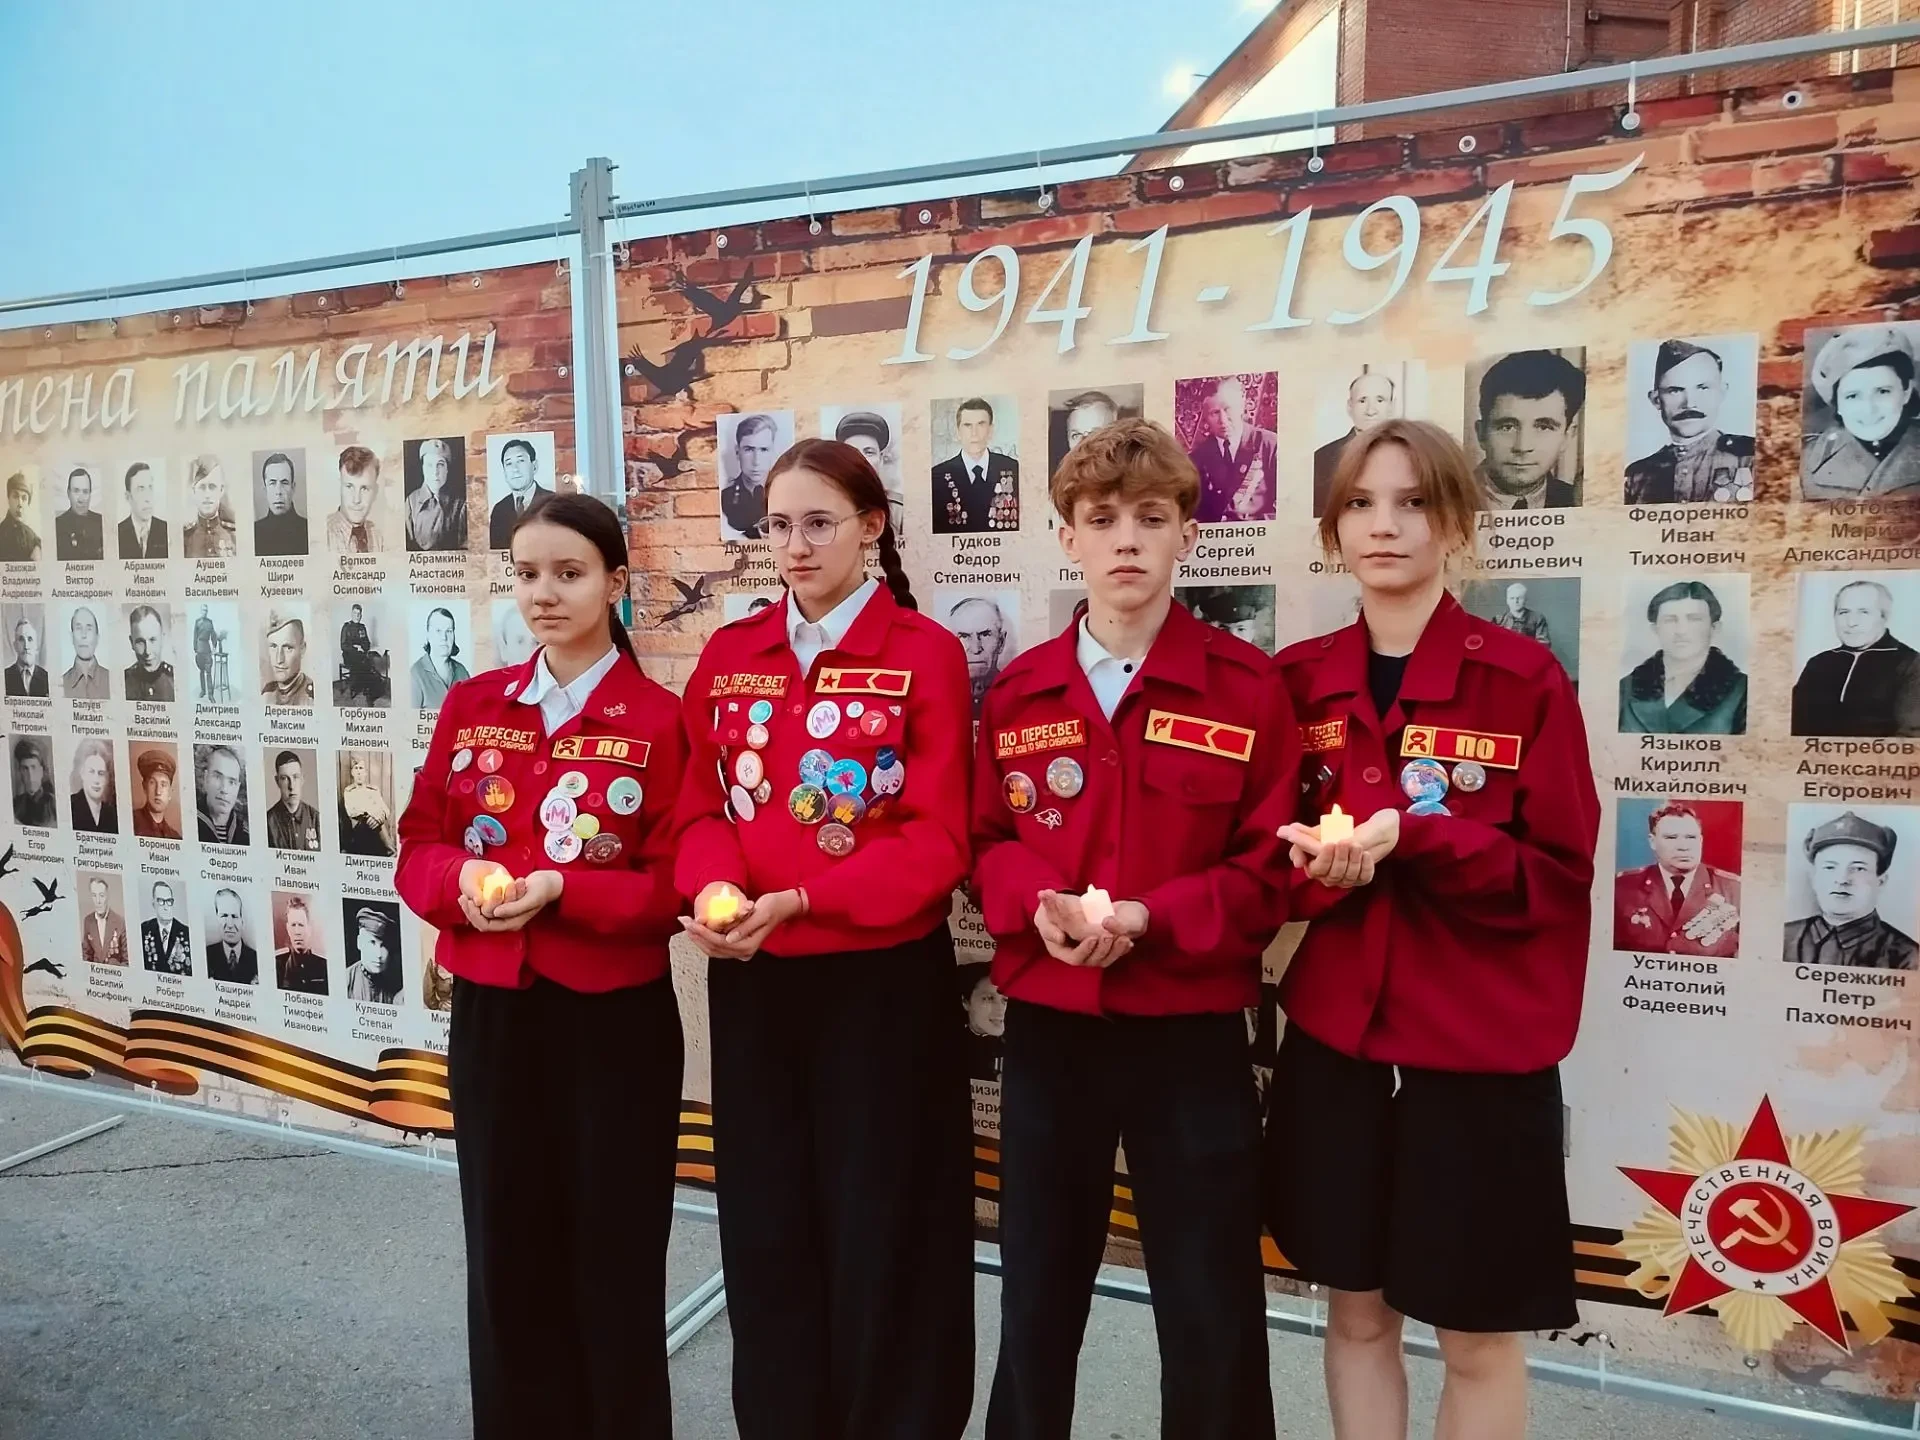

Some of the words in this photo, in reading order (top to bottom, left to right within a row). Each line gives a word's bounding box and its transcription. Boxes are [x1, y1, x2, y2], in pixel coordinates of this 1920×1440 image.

[171, 328, 505, 425] памяти
[1629, 506, 1749, 524] Федоренко
[1478, 514, 1565, 531] Денисов
[1198, 526, 1266, 539] тепанов
[1661, 528, 1714, 543] Иван
[952, 535, 1001, 549] Гудков
[1489, 535, 1554, 550] Федор
[1196, 544, 1255, 561] Сергей
[1630, 550, 1746, 566] Тихонович
[196, 560, 225, 571] Аушев
[259, 558, 304, 569] Авходеев
[340, 556, 376, 566] Волков
[409, 554, 467, 565] Абрамкина
[953, 554, 1000, 567] Федор
[124, 561, 165, 572] Абрамкин
[1179, 565, 1272, 578] Яковлевич
[134, 575, 154, 584] Иван
[195, 573, 227, 584] Андрей
[268, 572, 294, 582] Шири
[333, 570, 386, 581] Александр
[409, 569, 464, 579] Анастасия
[934, 571, 1021, 584] Степанович
[66, 576, 94, 586] Виктор
[125, 587, 166, 597] Иванович
[185, 586, 238, 597] Васильевич
[260, 586, 303, 597] Хузеевич
[333, 584, 382, 595] Осипович
[410, 583, 466, 594] Тихоновна
[713, 675, 729, 688] ПО
[730, 673, 787, 687] ПЕРЕСВЕТ
[73, 699, 101, 710] Балуев
[136, 701, 166, 713] Балуев
[195, 703, 239, 715] Дмитриев
[73, 712, 104, 722] Михаил
[265, 706, 313, 718] Дереганов
[339, 708, 386, 720] Горбунов
[134, 715, 171, 726] Василий
[194, 717, 241, 729] Александр
[271, 719, 305, 730] Максим
[71, 725, 109, 736] Петрович
[127, 727, 178, 739] Михайлович
[346, 722, 383, 733] Михаил
[999, 732, 1017, 747] ПО
[1021, 720, 1080, 743] ПЕРЕСВЕТ
[195, 730, 243, 742] Яковлевич
[258, 733, 319, 745] Герасимович
[457, 728, 472, 742] ПО
[474, 726, 536, 743] ПЕРЕСВЕТ
[341, 736, 389, 748] Иванович
[596, 739, 629, 758] ПО
[1455, 735, 1496, 760] ПО
[1641, 735, 1721, 751] Языков
[1804, 738, 1914, 758] Ястребов
[1641, 757, 1720, 772] Кирилл
[1797, 760, 1920, 778] Александр
[1614, 777, 1747, 795] Михайлович
[1804, 782, 1911, 802] Егорович
[28, 839, 46, 851] Егор
[75, 832, 117, 845] Братченко
[139, 838, 181, 851] Воронцов
[78, 845, 114, 857] Дмитрий
[149, 851, 170, 862] Иван
[276, 850, 315, 863] Истомин
[73, 856, 124, 871] Григорьевич
[209, 857, 238, 871] Федор
[284, 864, 307, 875] Иван
[345, 856, 394, 870] Дмитриев
[141, 864, 180, 876] Егорович
[200, 869, 253, 883] Степанович
[356, 871, 380, 882] Яков
[275, 877, 320, 891] Павлович
[341, 883, 400, 897] Зиновьевич
[90, 964, 122, 977] Котенко
[1633, 955, 1718, 974] Устинов
[89, 976, 124, 989] Василий
[157, 973, 182, 985] Клейн
[1795, 965, 1906, 988] Сережкин
[156, 986, 185, 998] Роберт
[215, 982, 254, 997] Каширин
[1624, 975, 1725, 996] Анатолий
[86, 988, 132, 1003] Иосифович
[285, 992, 323, 1007] Лобанов
[1823, 989, 1876, 1009] Петр
[142, 995, 206, 1015] Александрович
[218, 996, 251, 1009] Андрей
[1622, 995, 1726, 1017] Фадеевич
[214, 1008, 257, 1023] Иванович
[283, 1005, 324, 1020] Тимофей
[355, 1003, 398, 1018] Кулешов
[359, 1017, 393, 1030] Степан
[1786, 1007, 1911, 1031] Пахомович
[284, 1018, 328, 1034] Иванович
[351, 1028, 403, 1046] Елисеевич
[1688, 1165, 1822, 1274] ОТЕЧЕСТВЕННАЯ
[1786, 1219, 1834, 1286] ВОЙНА
